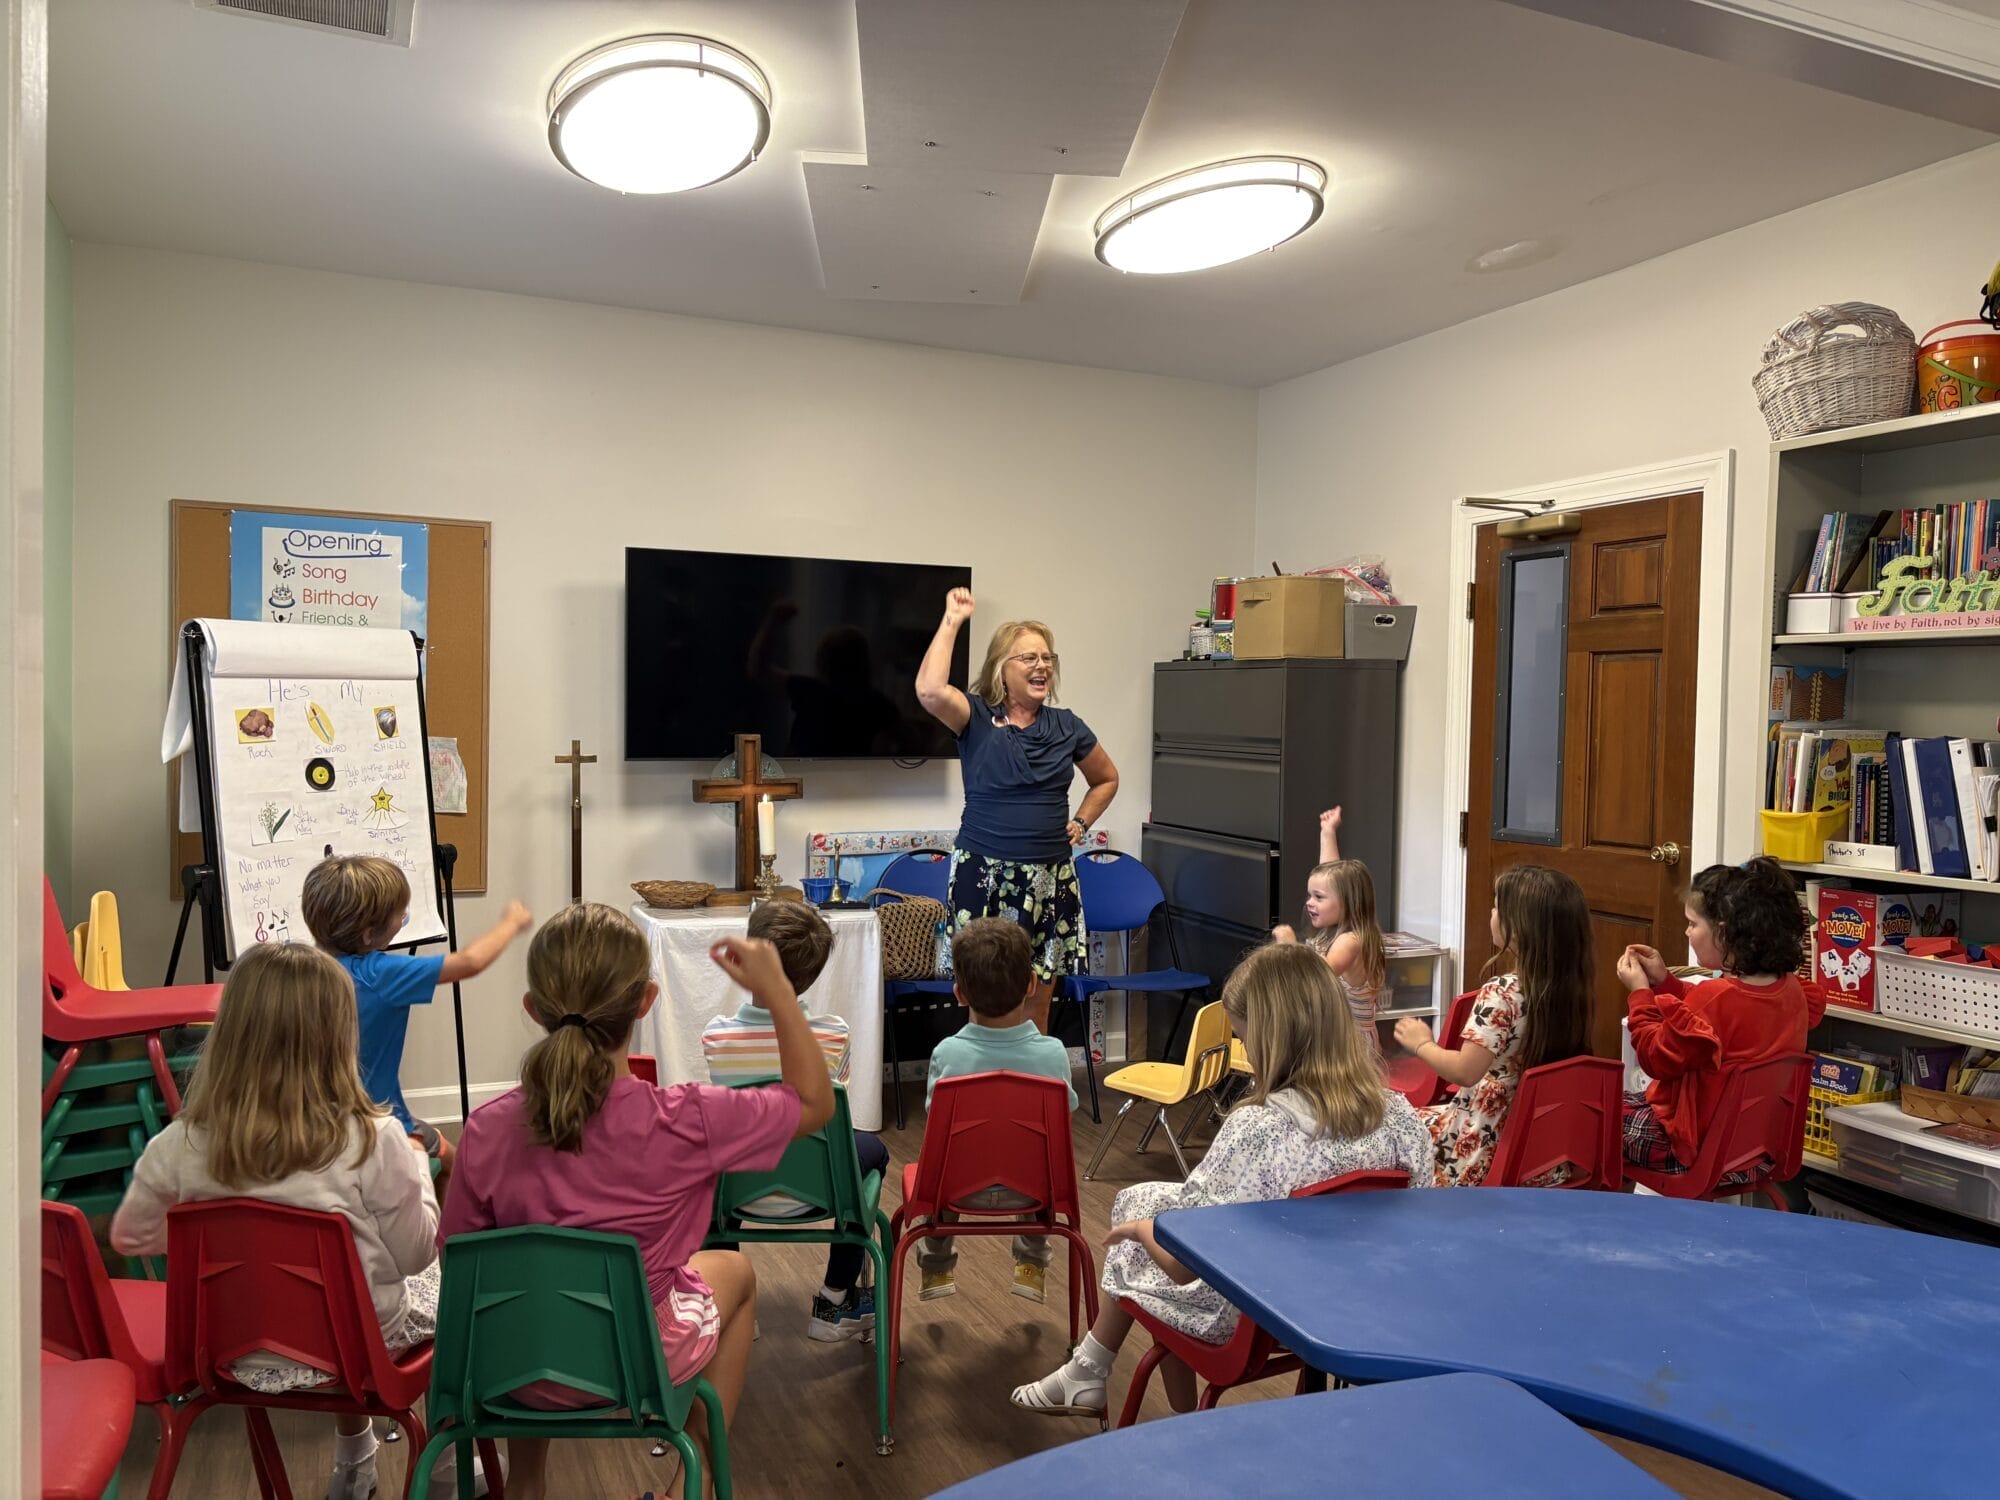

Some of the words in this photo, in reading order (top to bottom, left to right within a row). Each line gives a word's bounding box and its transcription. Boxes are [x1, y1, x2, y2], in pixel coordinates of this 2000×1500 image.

[288, 530, 382, 556] Opening
[302, 563, 347, 583] Song
[302, 588, 379, 610] Birthday
[302, 611, 353, 626] Friends
[358, 615, 369, 626] &
[1853, 621, 1869, 631] We
[1872, 619, 1890, 630] live
[1894, 619, 1907, 634] by
[1967, 616, 1980, 627] by
[268, 678, 310, 702] He's
[315, 744, 347, 755] SWORD
[373, 741, 407, 753] SHIELD
[238, 859, 252, 874] No
[257, 855, 295, 870] matter
[266, 876, 281, 892] you
[1825, 920, 1866, 939] MOVE!
[1881, 918, 1913, 936] MOVE!
[1811, 1075, 1829, 1087] salm
[1829, 1080, 1849, 1093] Book
